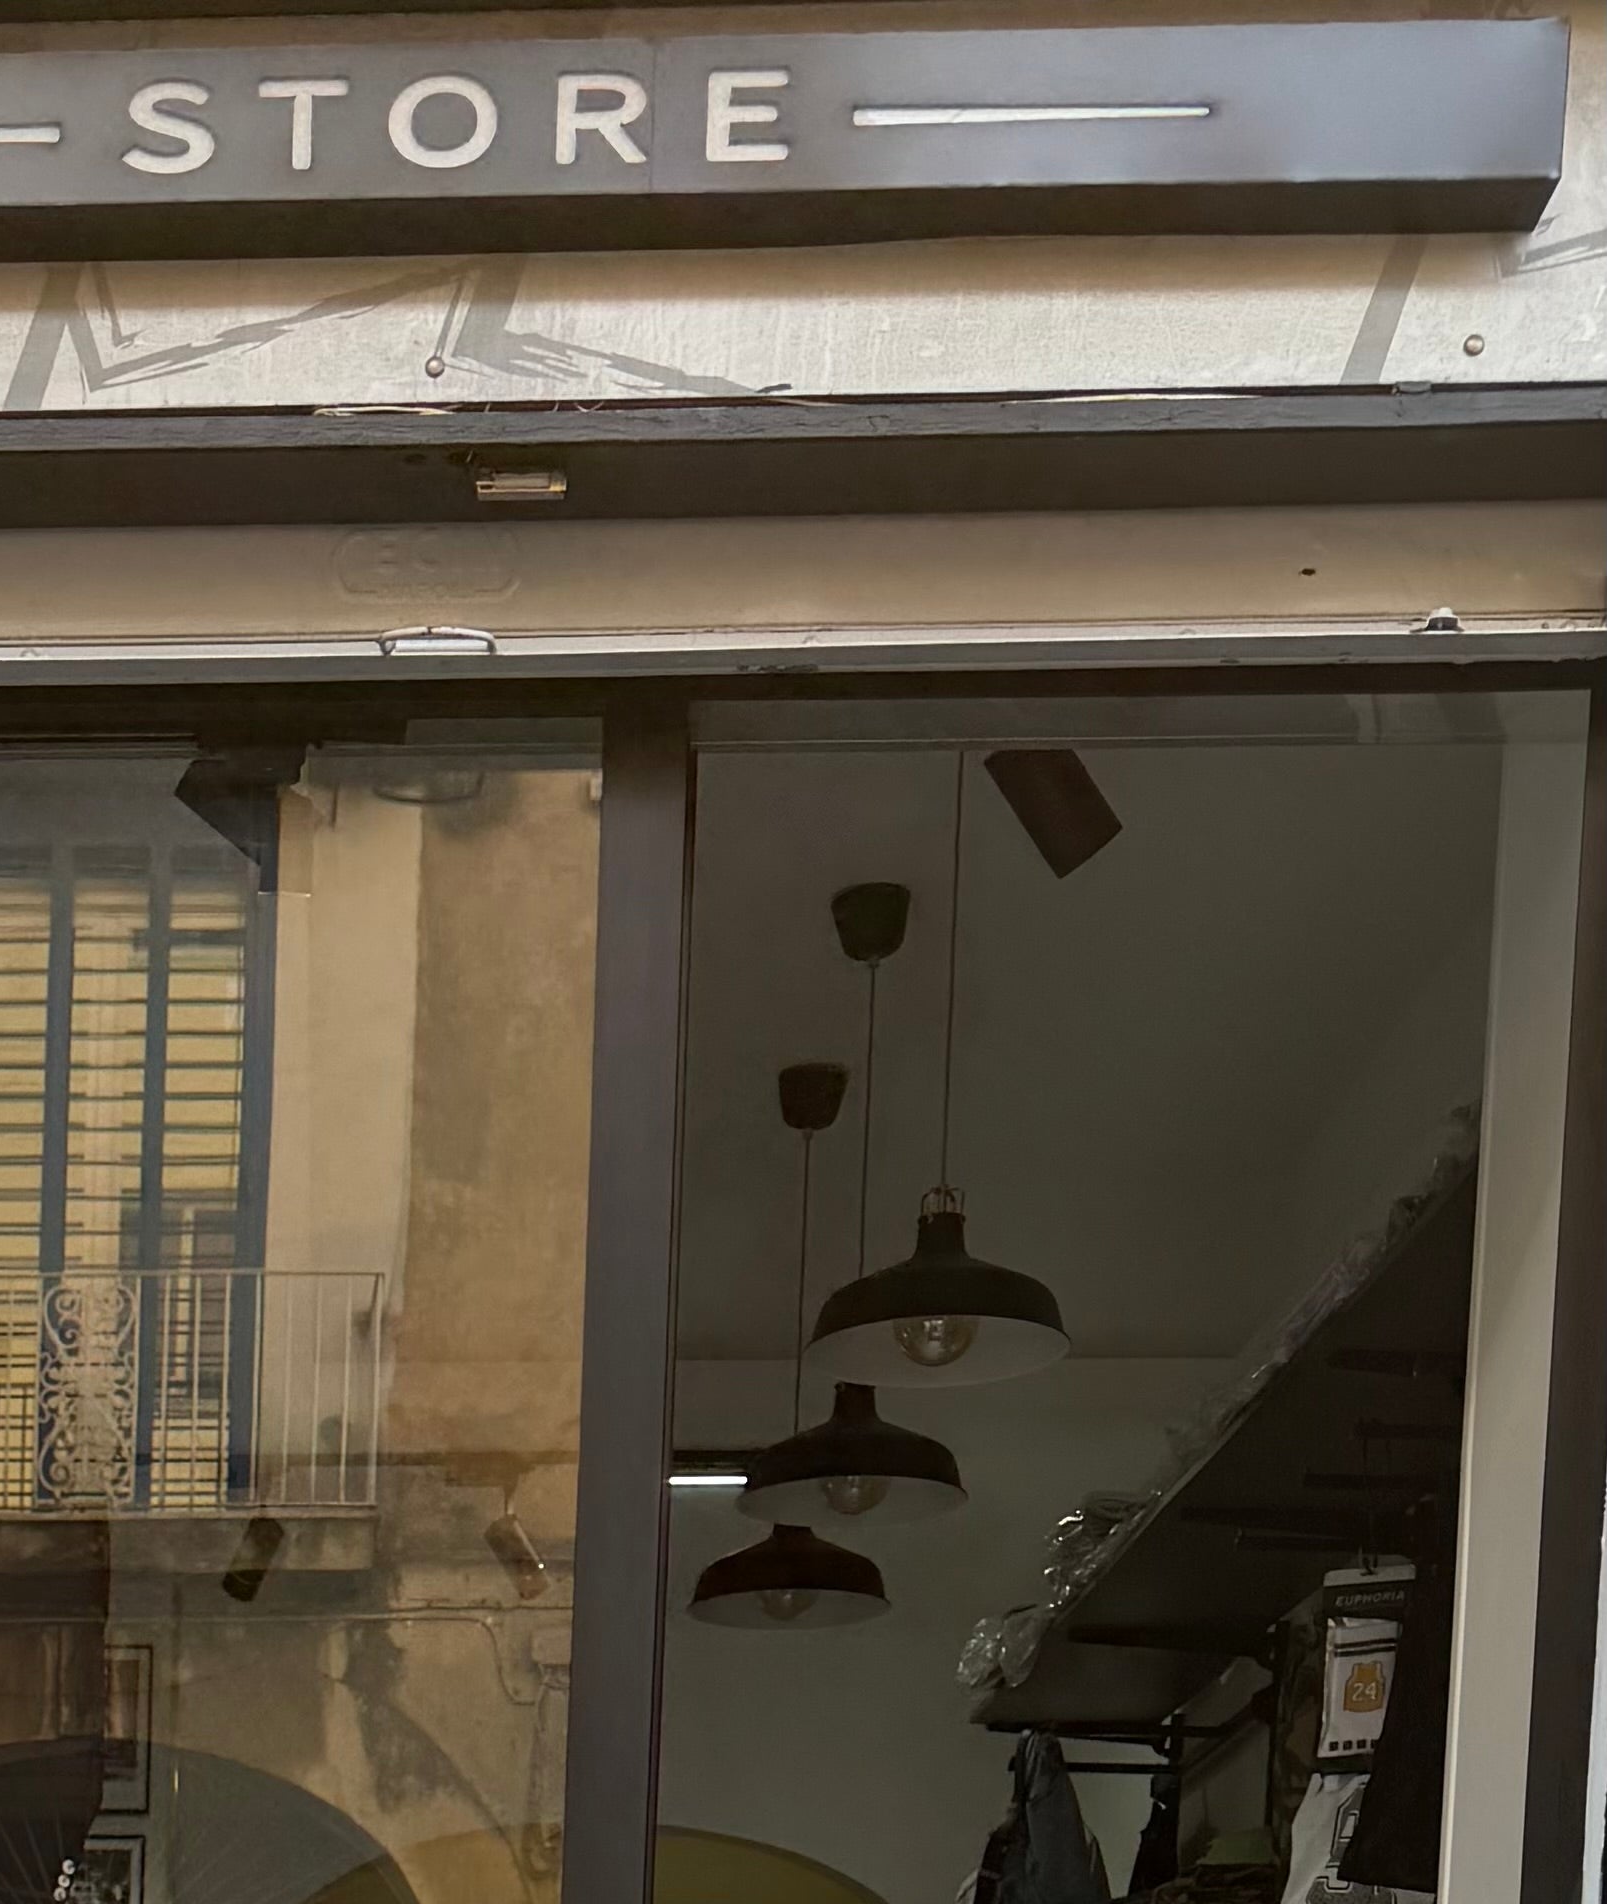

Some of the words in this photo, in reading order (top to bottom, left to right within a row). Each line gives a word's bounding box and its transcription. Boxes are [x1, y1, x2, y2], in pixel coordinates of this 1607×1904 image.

[121, 67, 794, 176] STORE
[1334, 1590, 1406, 1607] EUPHORIA
[1351, 1681, 1378, 1702] 24
